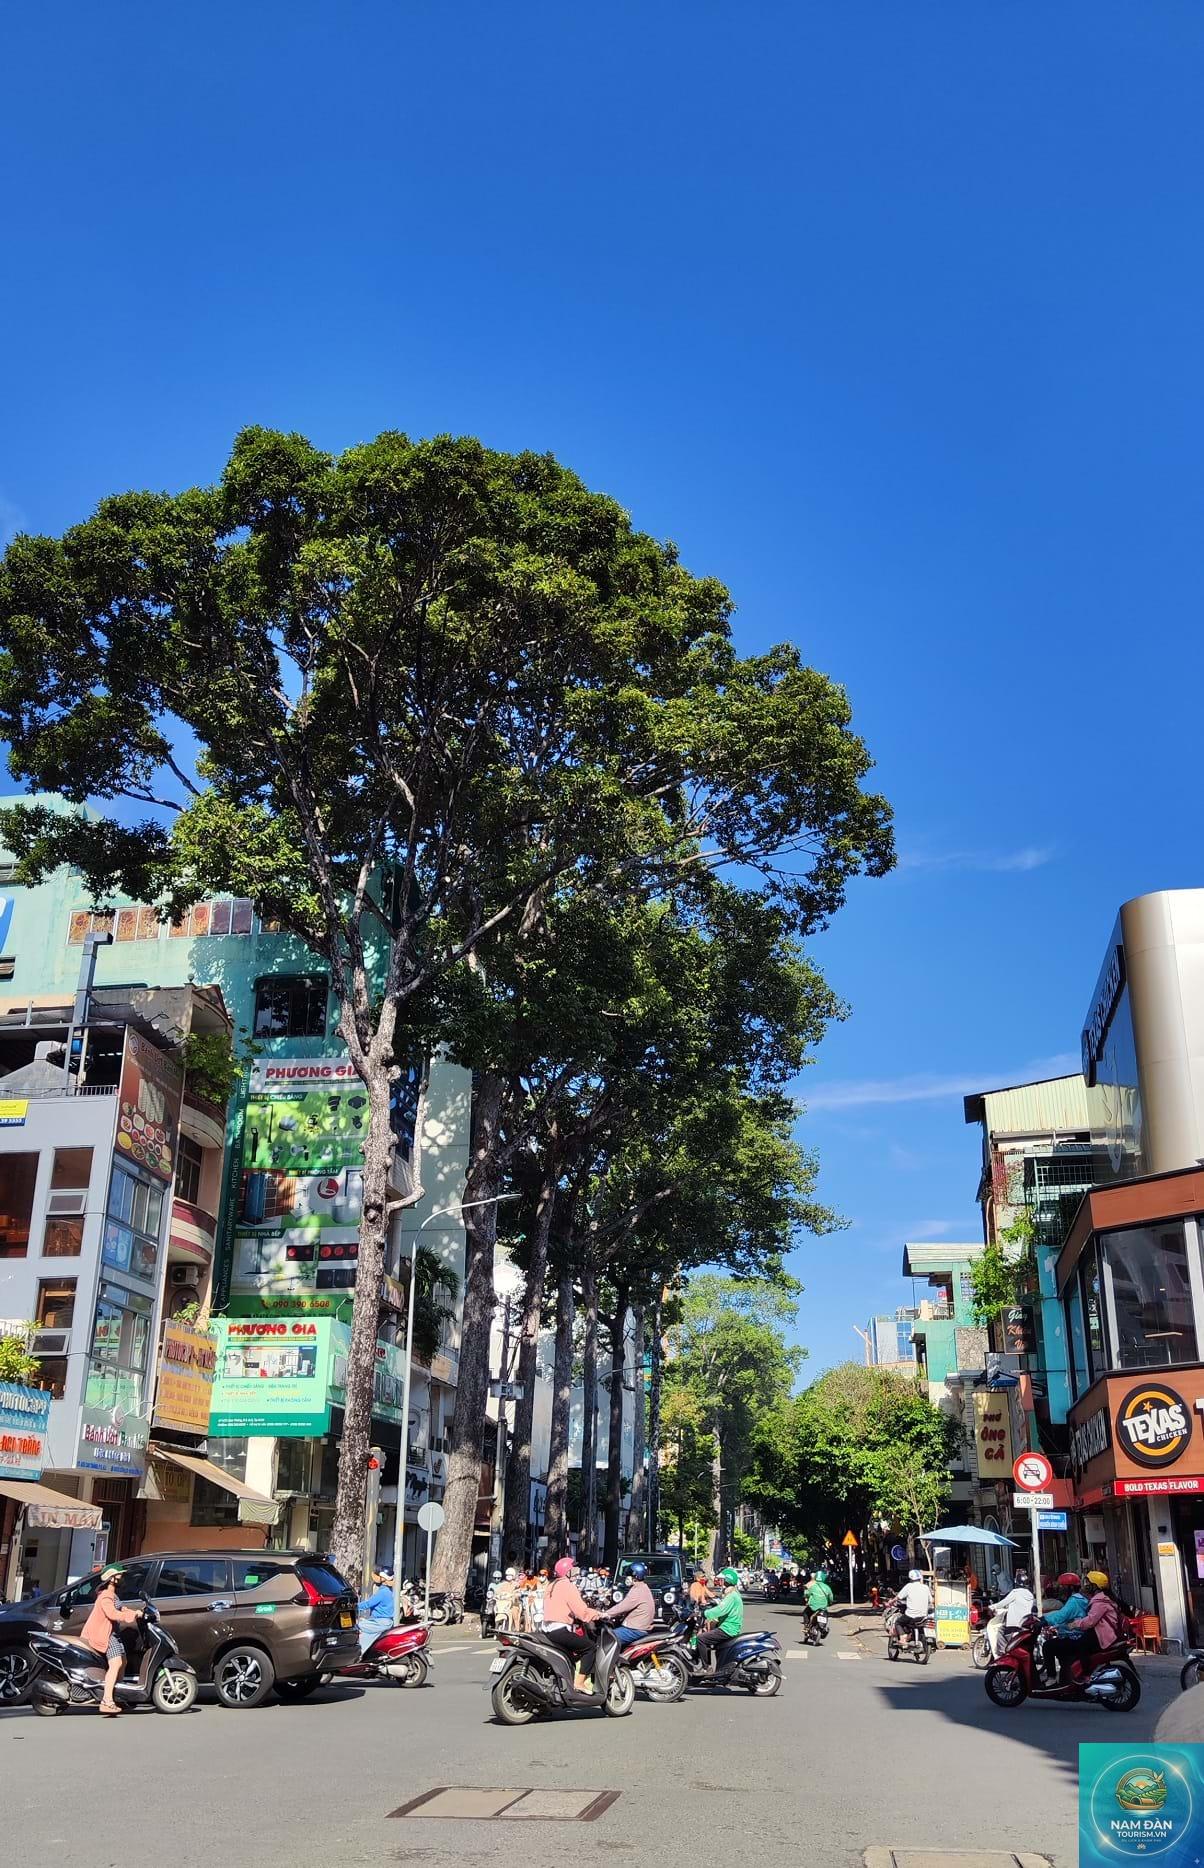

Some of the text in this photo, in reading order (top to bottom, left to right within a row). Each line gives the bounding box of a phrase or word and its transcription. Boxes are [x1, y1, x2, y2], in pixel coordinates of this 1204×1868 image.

[265, 1066, 332, 1079] PHƯƠNG
[228, 1322, 287, 1336] PHƯƠNG
[291, 1323, 317, 1335] GIA
[1123, 1404, 1186, 1443] TEXAS
[981, 1426, 1006, 1441] ÔNG
[1156, 1428, 1188, 1442] CHICKEN
[1124, 1480, 1199, 1492] BOLD TEXAS FLAVOR
